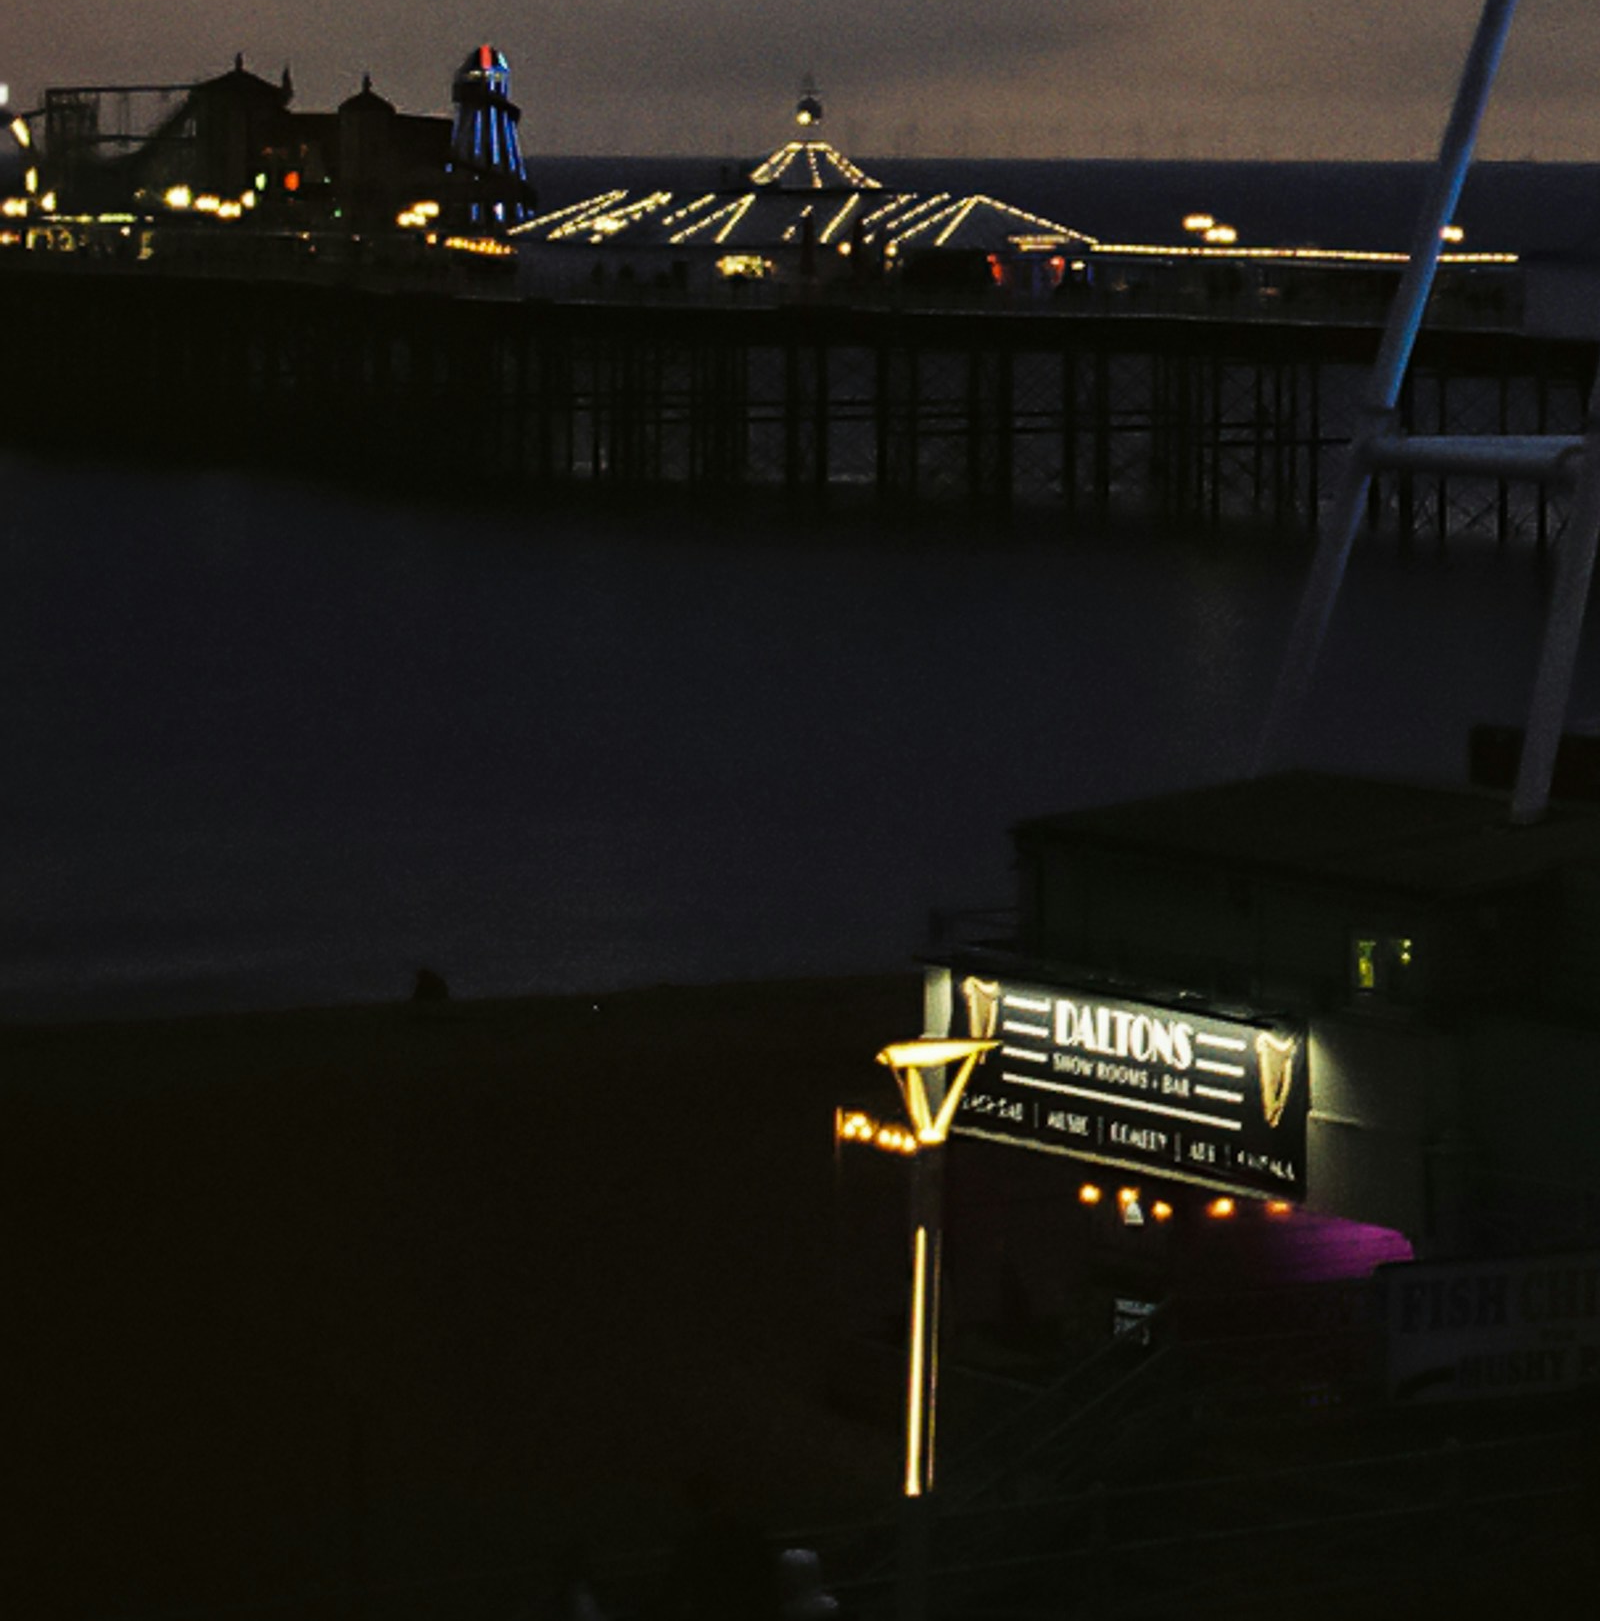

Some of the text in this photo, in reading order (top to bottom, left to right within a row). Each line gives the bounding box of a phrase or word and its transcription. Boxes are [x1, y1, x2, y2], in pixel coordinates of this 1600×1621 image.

[1054, 999, 1194, 1071] DALTONS
[1052, 1052, 1095, 1078] SHOW
[1096, 1057, 1148, 1090] ROOMS
[1161, 1072, 1190, 1097] BAR
[1401, 1273, 1508, 1334] FISH
[1458, 1349, 1567, 1389] MUSHY
